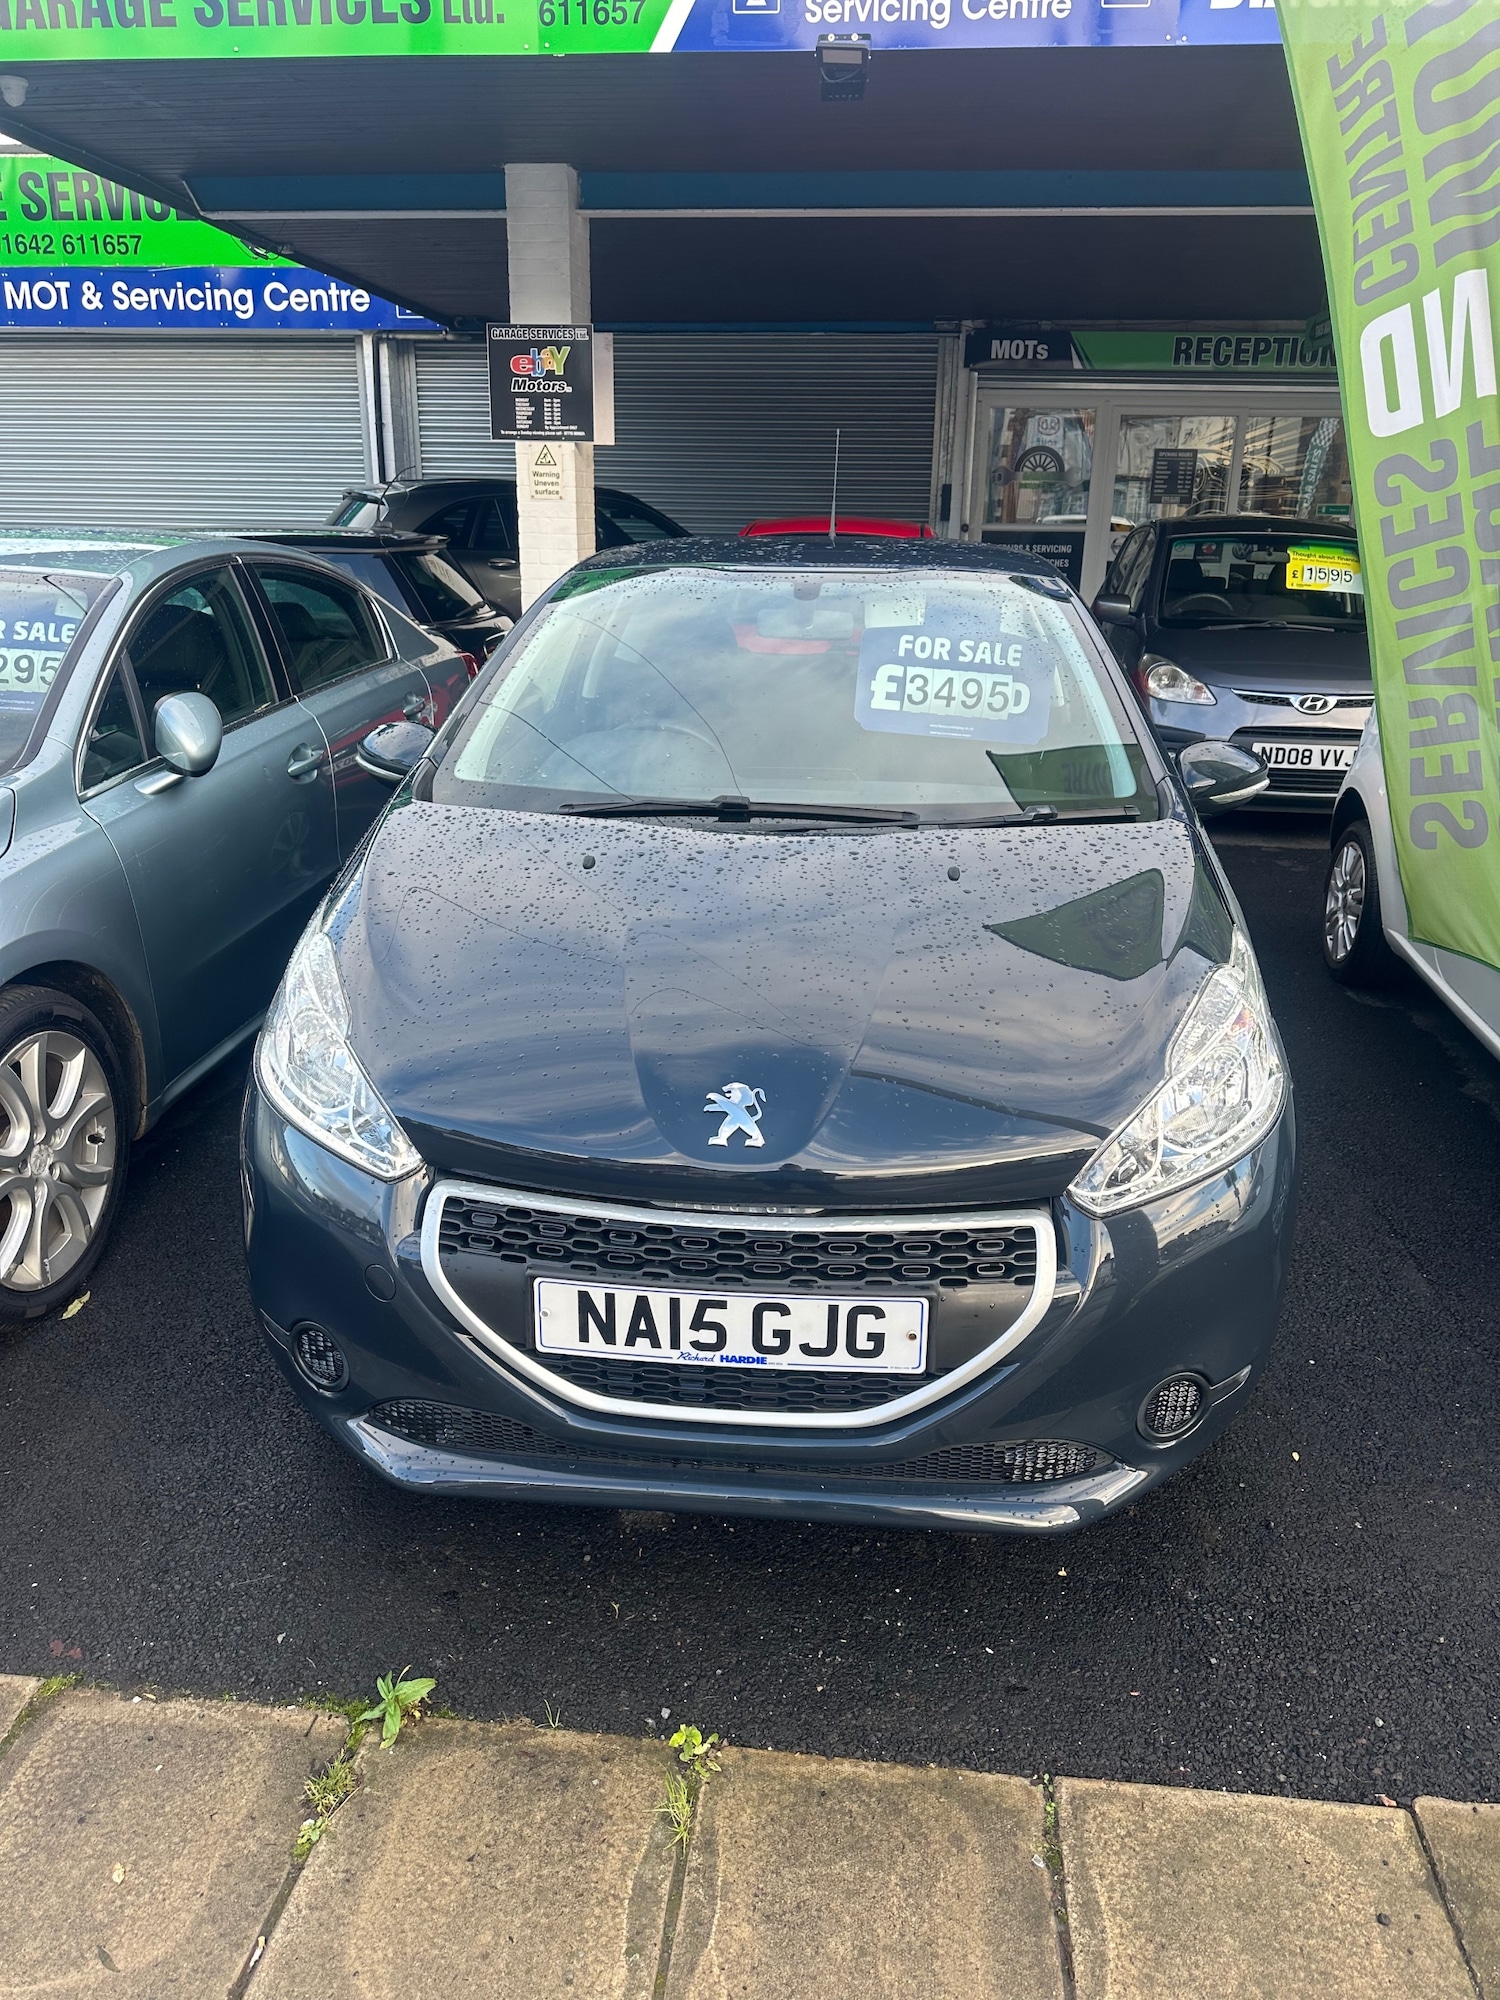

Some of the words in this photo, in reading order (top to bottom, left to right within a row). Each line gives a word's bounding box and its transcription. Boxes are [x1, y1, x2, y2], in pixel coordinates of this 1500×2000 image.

[539, 0, 643, 27] 611657
[62, 233, 142, 255] 611657
[3, 281, 70, 311] MOT
[81, 281, 104, 310] &
[112, 280, 253, 320] Servicing
[263, 282, 370, 312] Centre
[491, 328, 529, 340] GARAGE
[530, 328, 574, 340] SERVICES
[990, 339, 1049, 361] MOTs
[511, 378, 567, 393] Motors
[532, 470, 560, 480] Warning
[1032, 544, 1072, 554] SERVICING
[1292, 550, 1317, 559] Thought
[1306, 567, 1353, 583] 1595
[13, 620, 76, 644] SALE
[898, 634, 951, 661] FOR
[958, 639, 1023, 667] SALE
[751, 1301, 886, 1359] GJG
[676, 1350, 716, 1364] Richard
[719, 1354, 768, 1366] HARDIE
